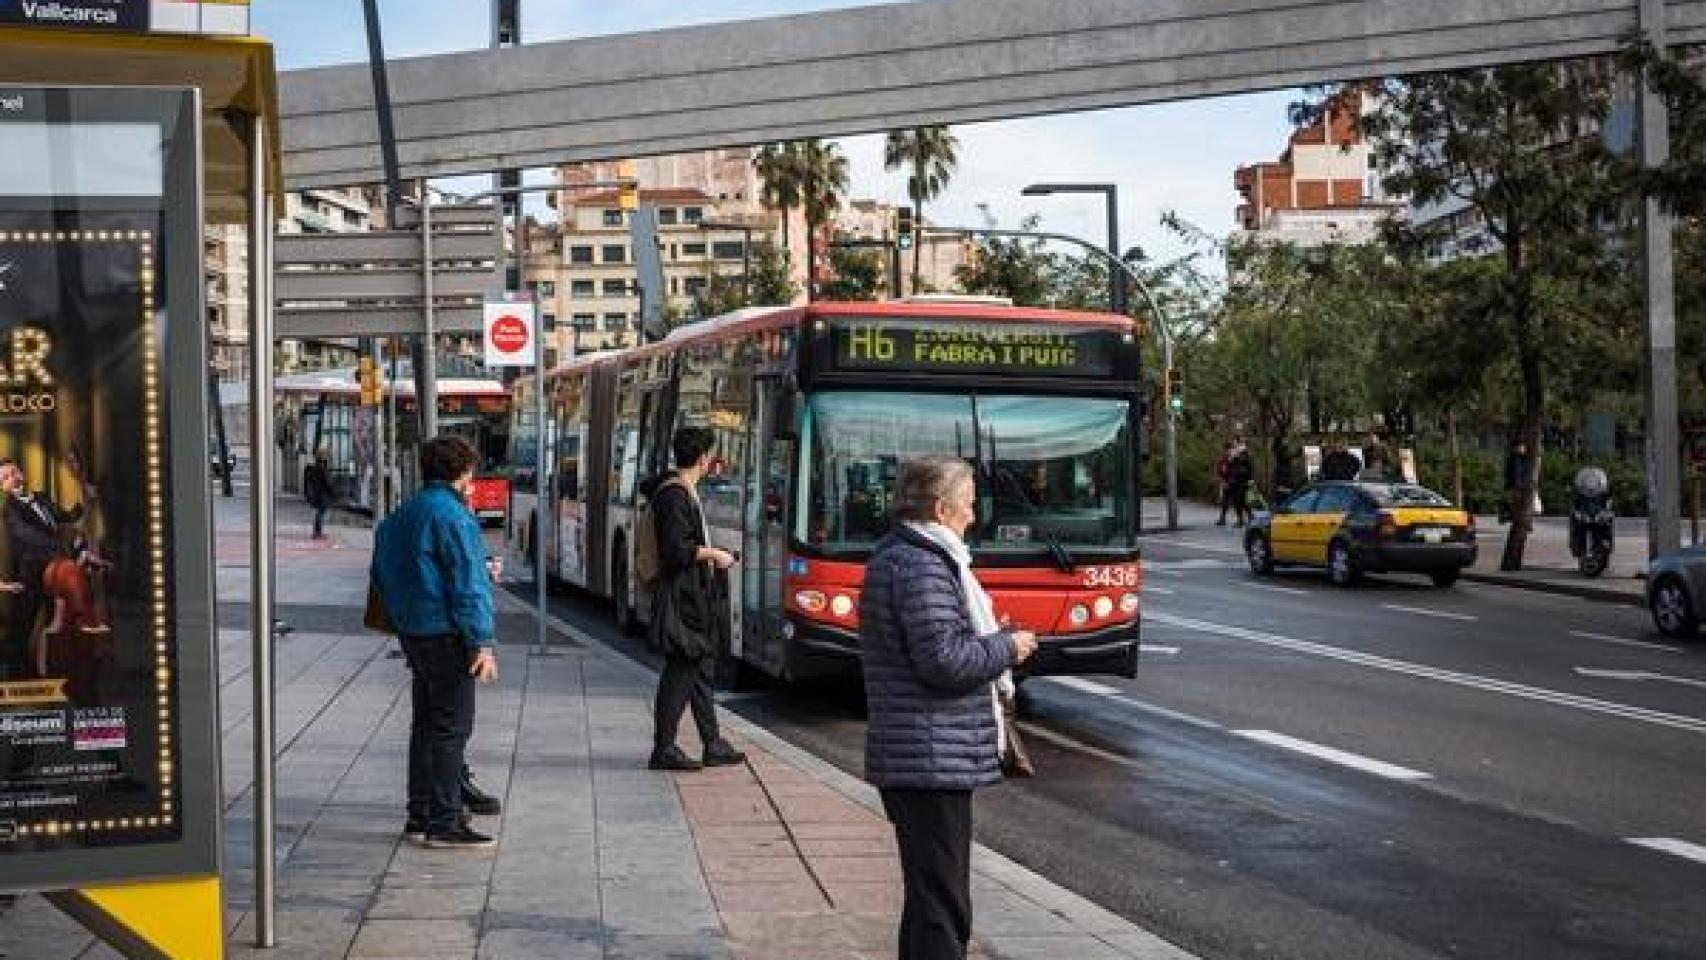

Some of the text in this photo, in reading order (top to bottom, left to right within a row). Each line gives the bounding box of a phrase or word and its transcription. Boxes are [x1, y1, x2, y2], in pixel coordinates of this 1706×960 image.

[22, 1, 118, 24] Vallcarca
[849, 323, 894, 360] H6
[914, 343, 1076, 367] FABRA I PUIG
[1083, 566, 1138, 586] 3436
